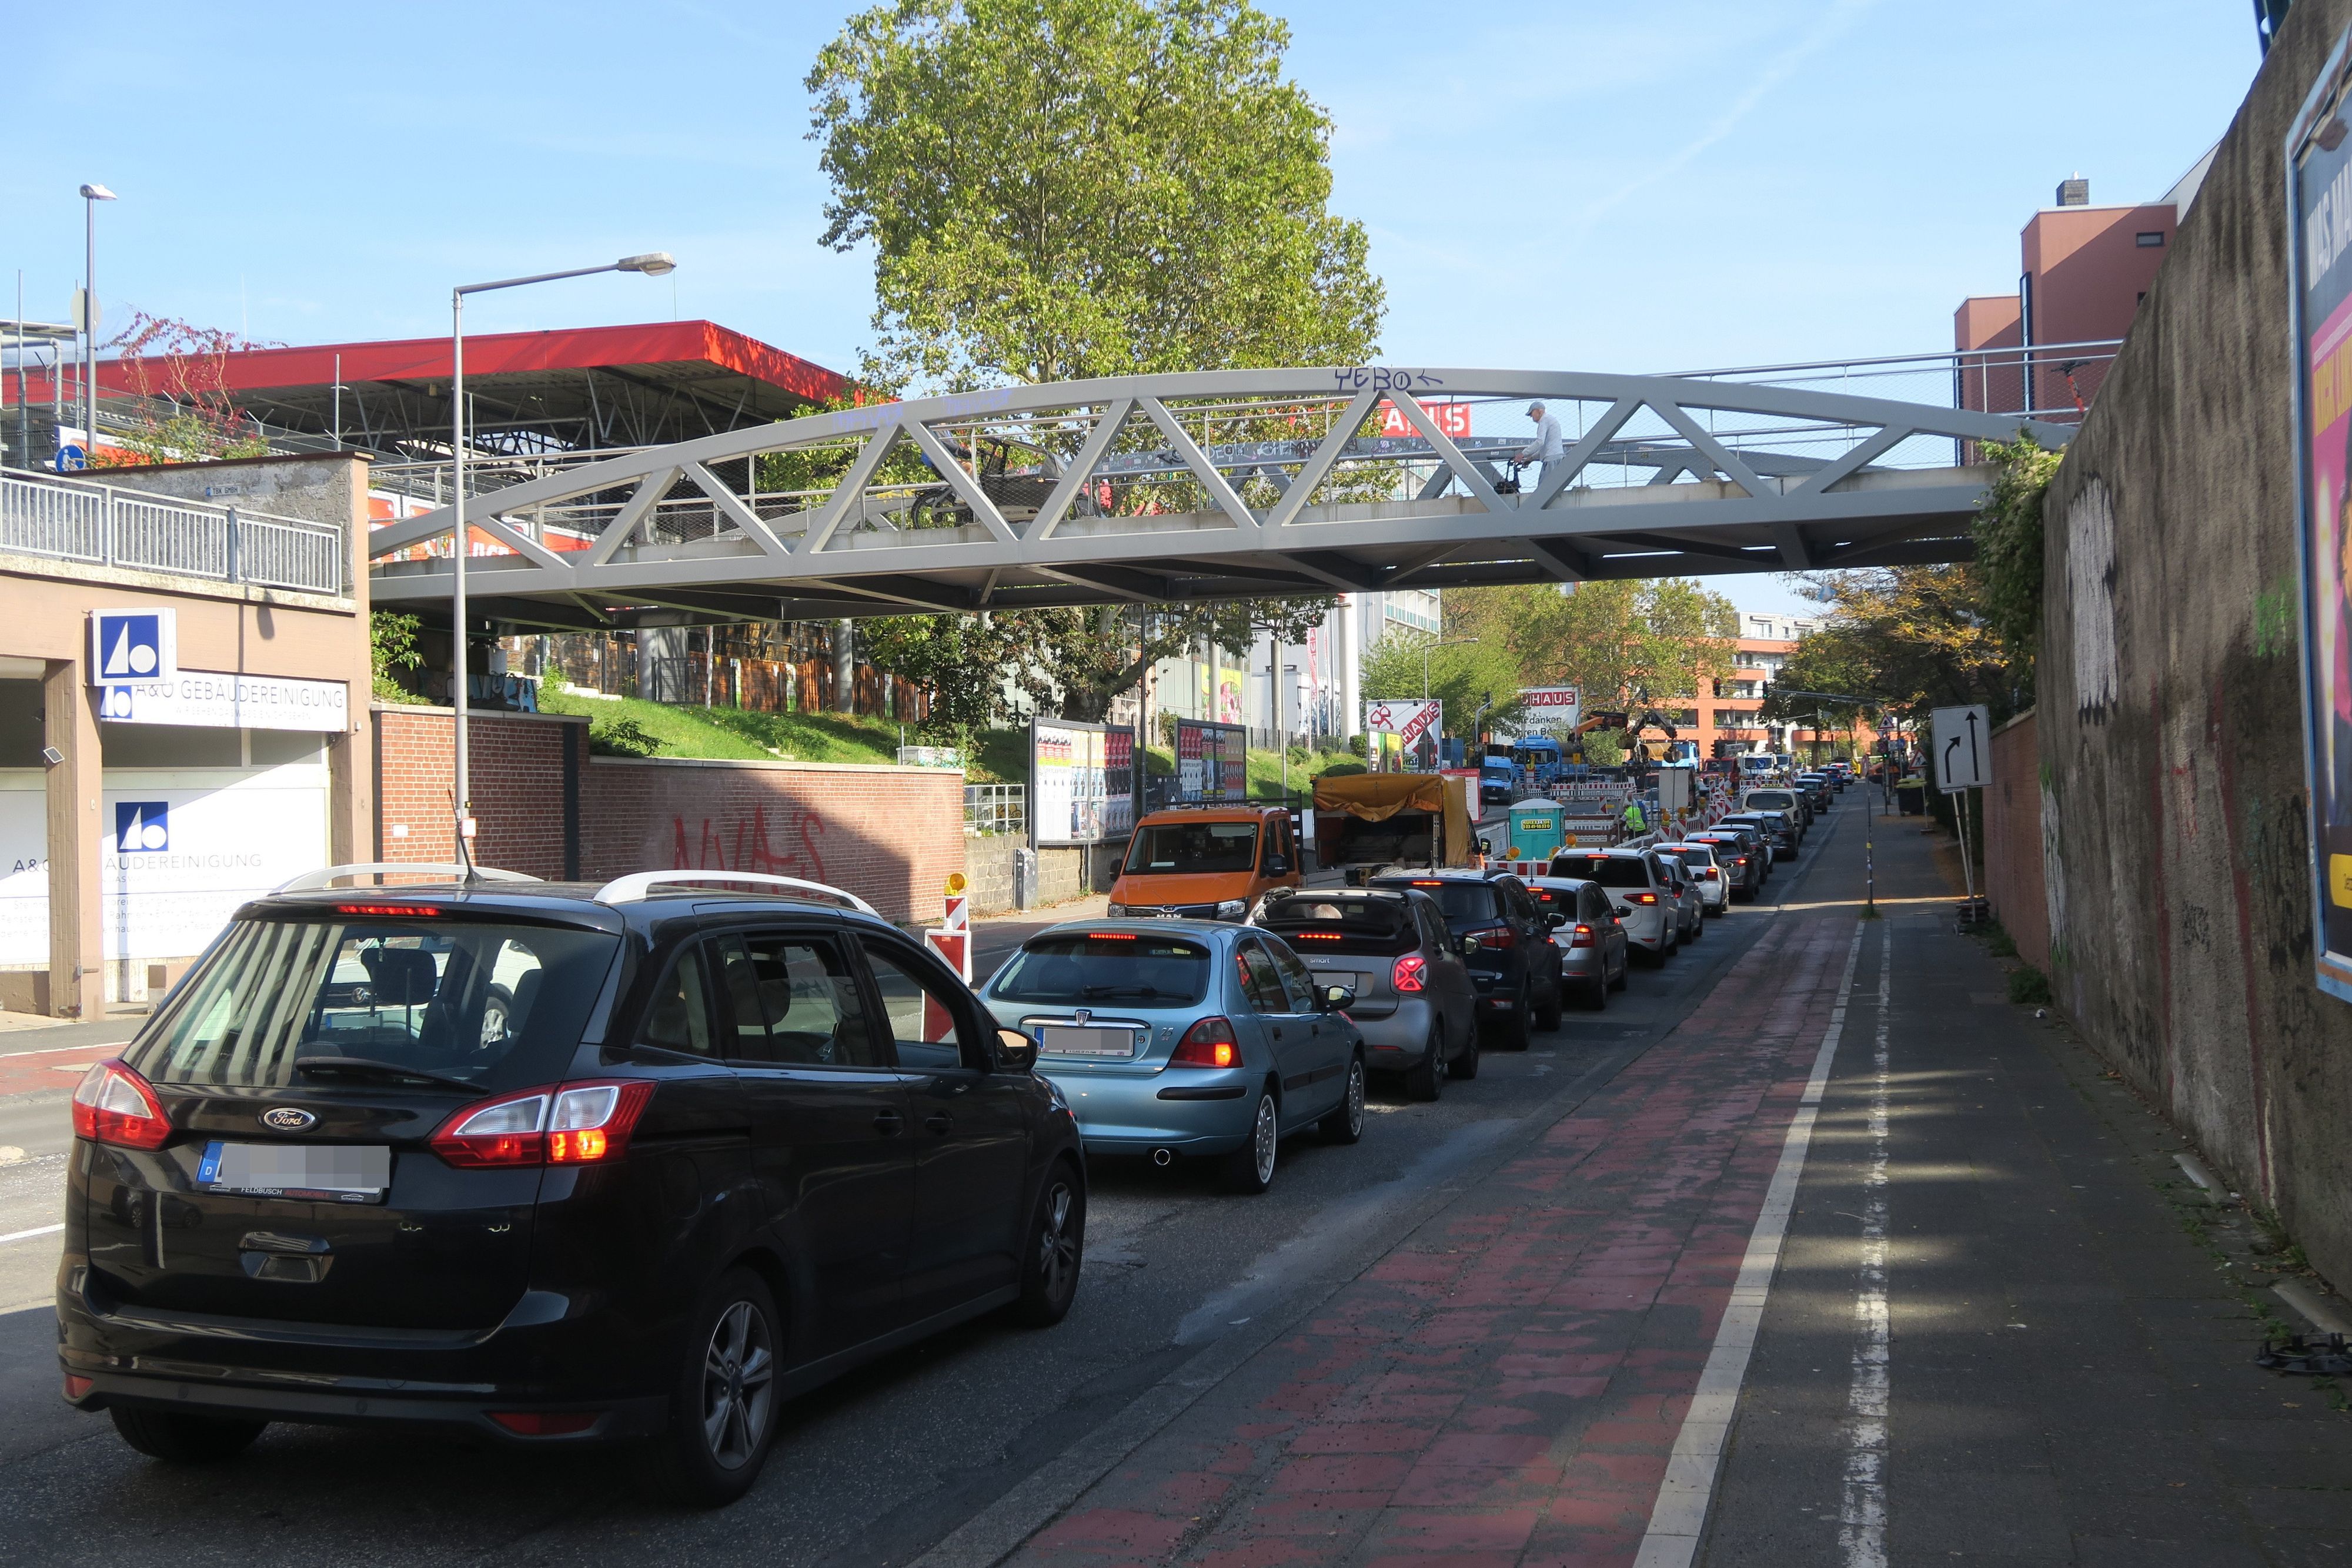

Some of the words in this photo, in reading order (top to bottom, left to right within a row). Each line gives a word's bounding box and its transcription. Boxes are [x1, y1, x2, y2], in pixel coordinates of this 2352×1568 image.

[181, 678, 343, 708] GEBÄUDEREINIGUNG
[1529, 716, 1561, 724] danken
[1160, 1027, 1174, 1037] 25
[273, 1109, 303, 1126] Ford
[205, 1166, 213, 1176] D
[241, 1187, 282, 1195] FELDBUSCH
